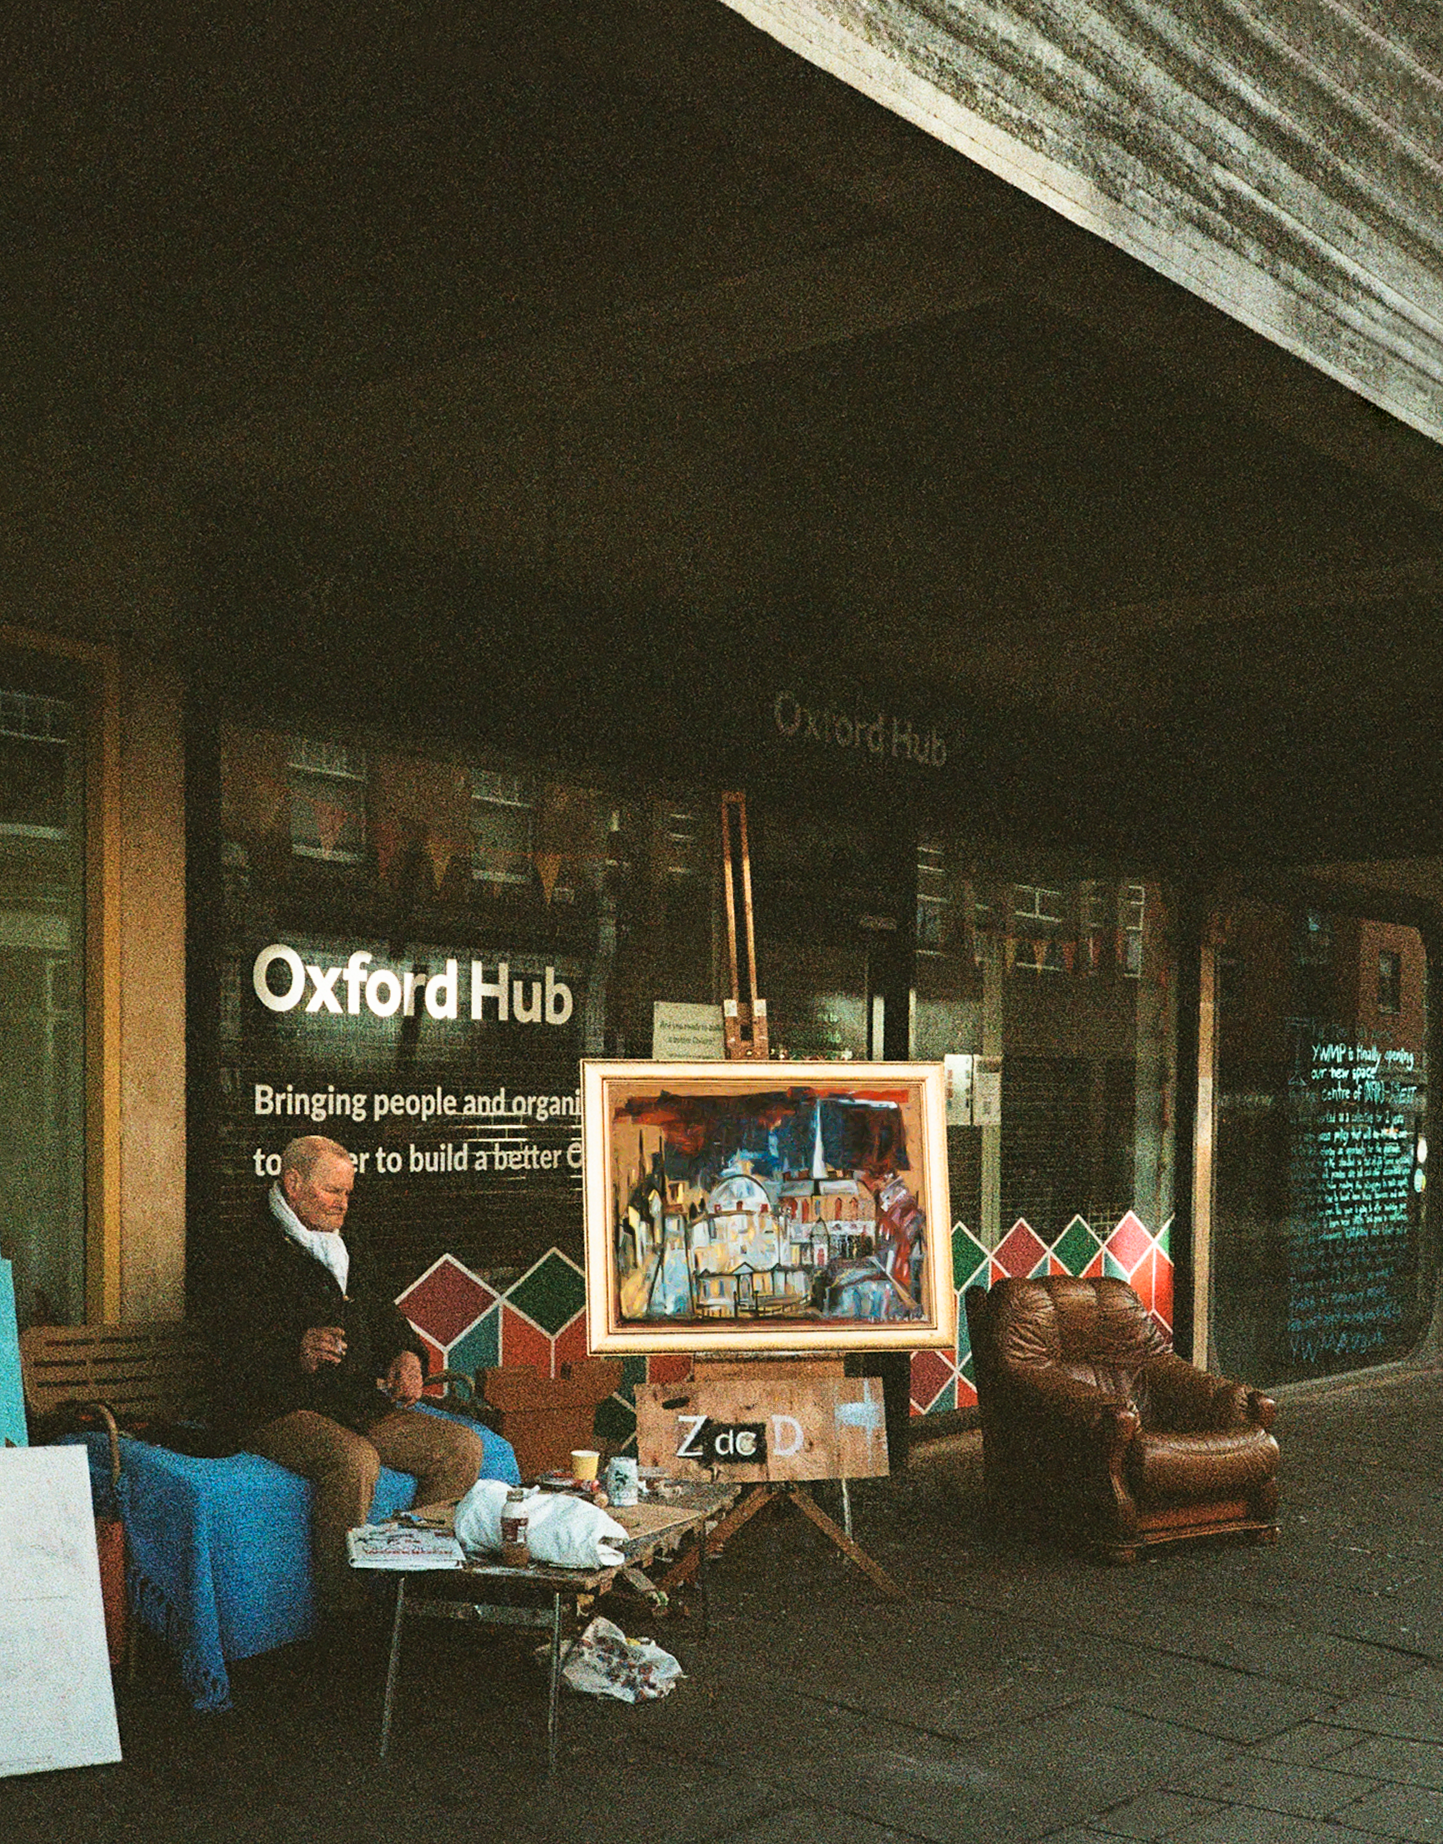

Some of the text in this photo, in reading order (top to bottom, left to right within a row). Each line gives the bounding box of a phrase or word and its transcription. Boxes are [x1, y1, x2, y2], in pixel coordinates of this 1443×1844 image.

[774, 690, 948, 767] Oxford Hub
[253, 944, 573, 1025] Oxford Hub
[1310, 1067, 1328, 1080] our
[1330, 1066, 1349, 1079] new
[254, 1083, 367, 1122] Bringing
[373, 1085, 457, 1122] people
[462, 1087, 506, 1116] and
[253, 1147, 368, 1176] toer
[376, 1146, 403, 1174] to
[409, 1142, 469, 1173] build
[474, 1151, 488, 1171] a
[492, 1143, 563, 1171] better
